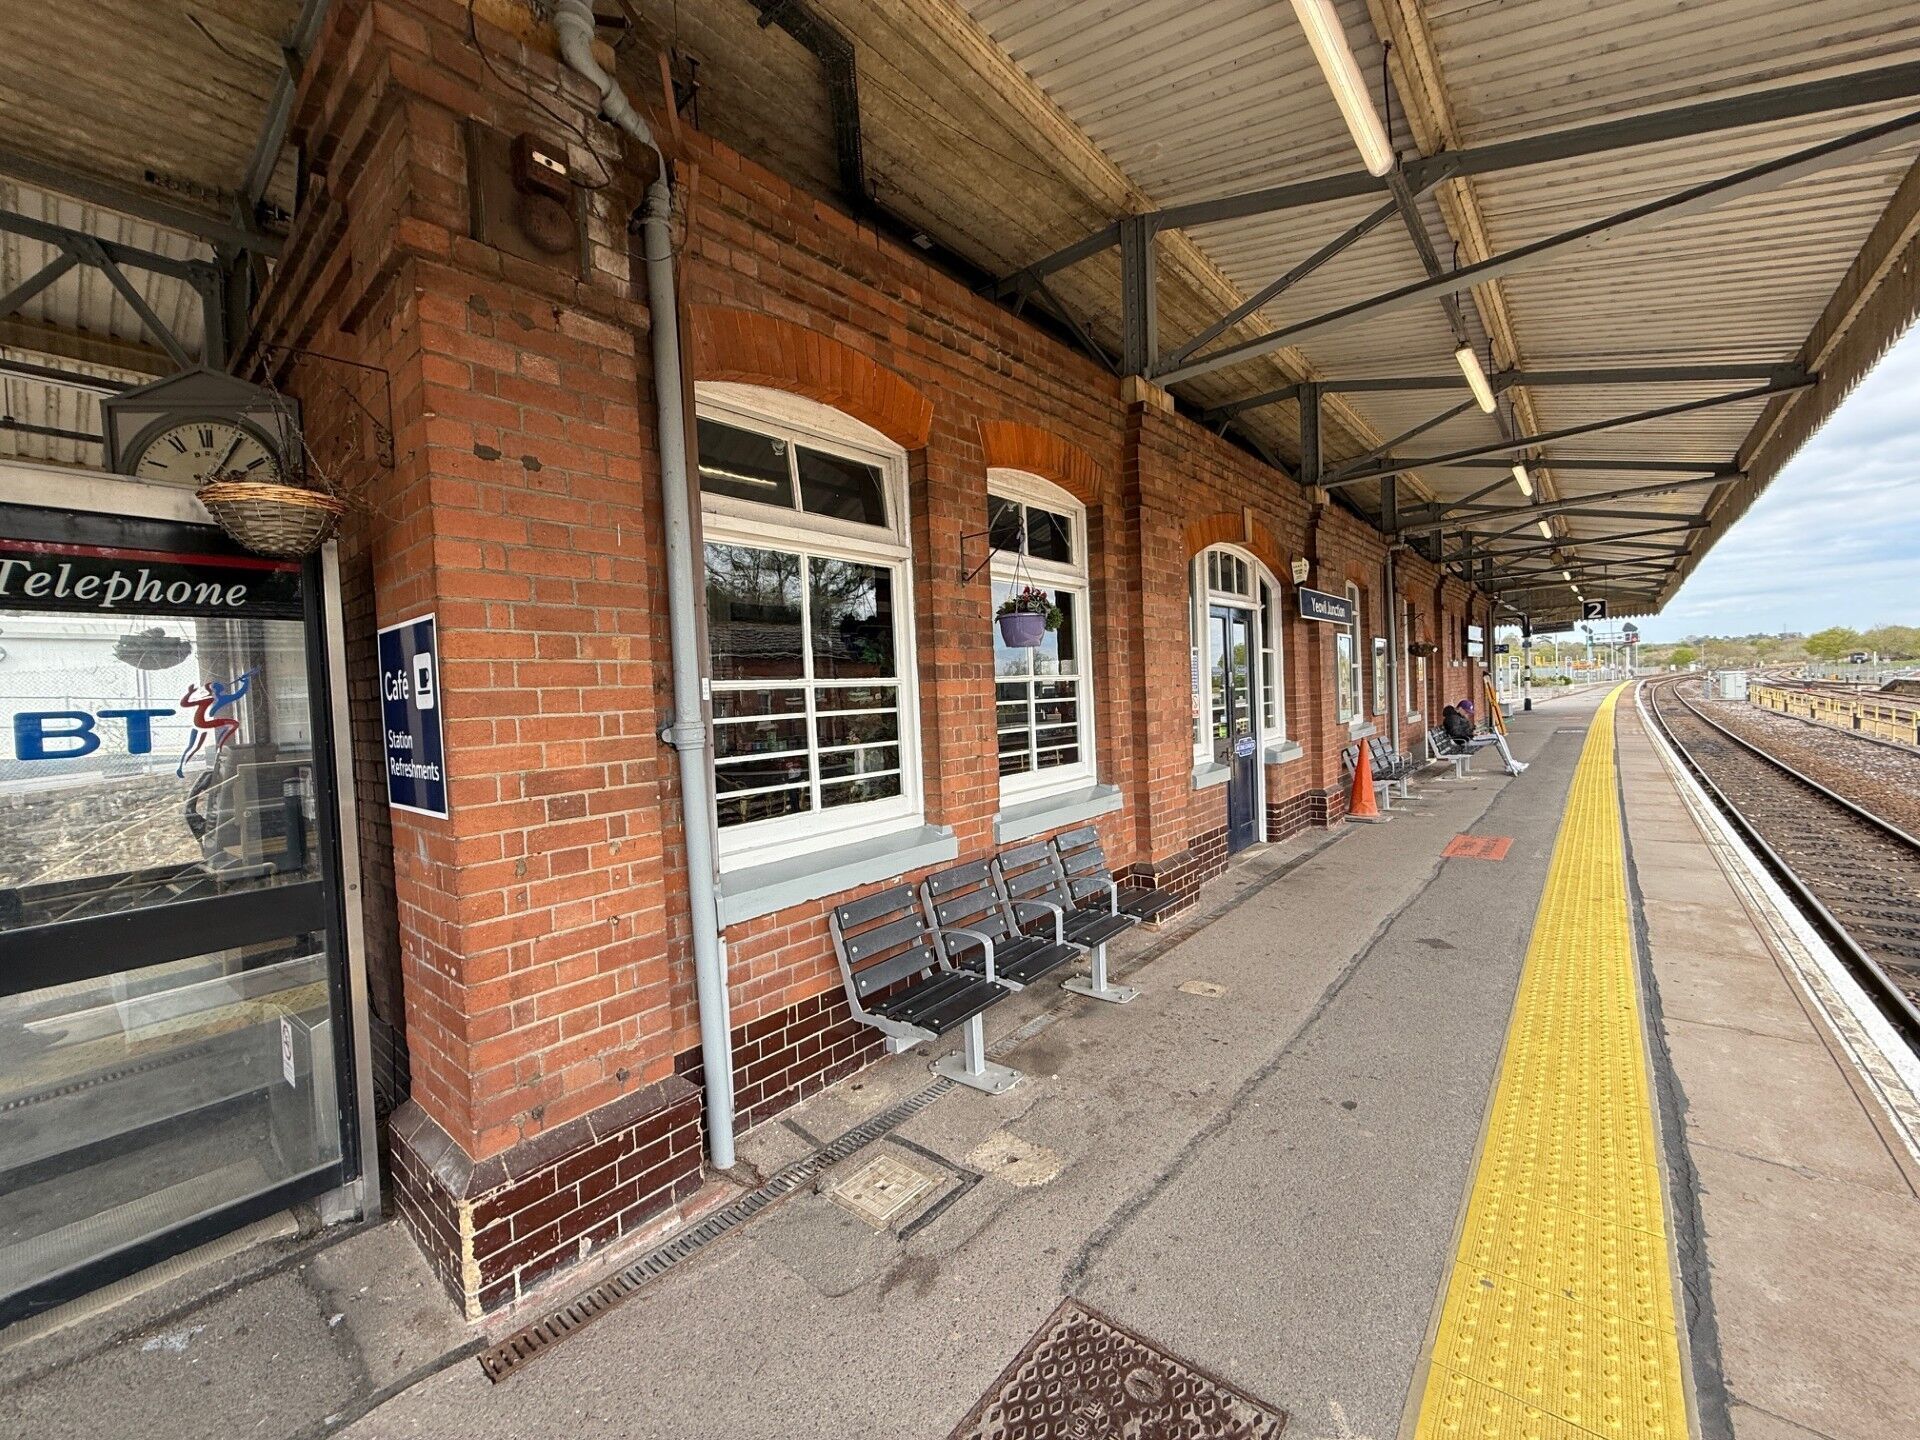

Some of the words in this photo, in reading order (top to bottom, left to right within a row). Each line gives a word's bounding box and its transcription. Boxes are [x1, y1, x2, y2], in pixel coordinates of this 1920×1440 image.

[0, 558, 248, 608] Telephone
[1311, 597, 1327, 614] Yeovil
[1327, 601, 1346, 617] Junction
[1587, 602, 1603, 619] 2
[384, 669, 410, 701] Café
[13, 709, 176, 761] BT
[388, 729, 413, 749] Station
[390, 757, 440, 781] Refreshments
